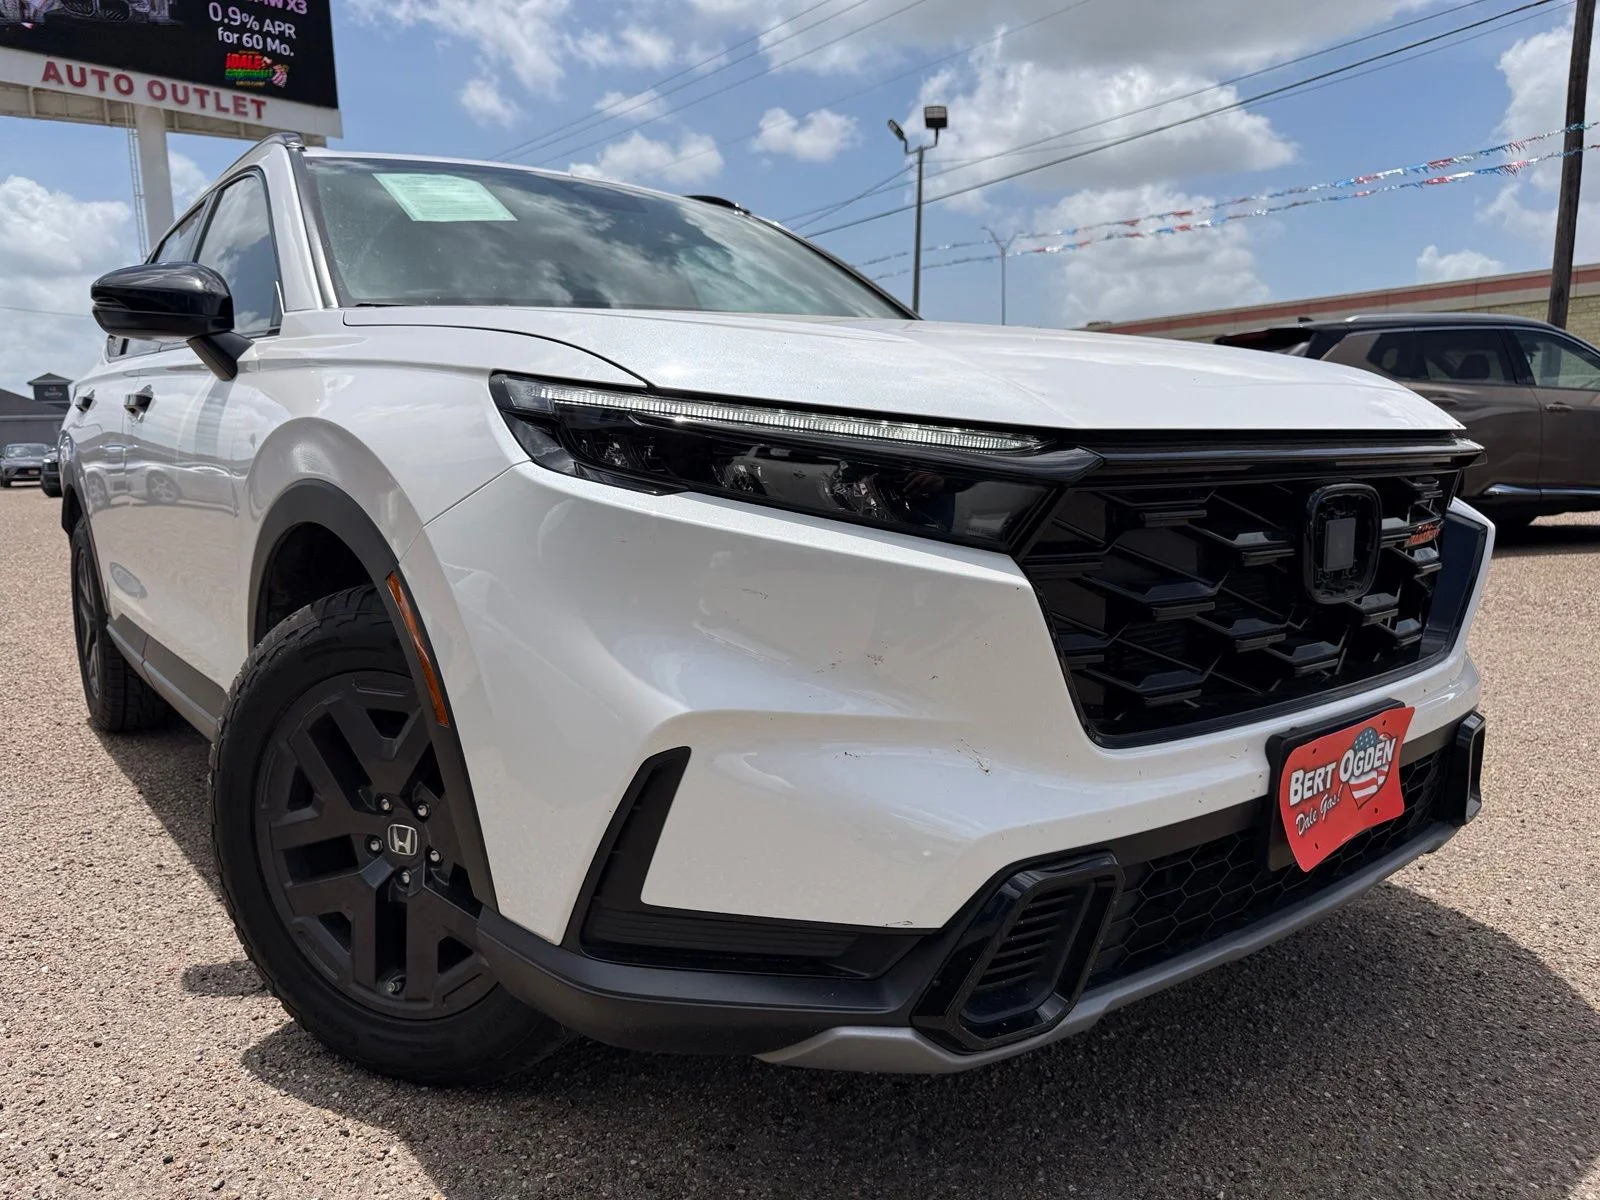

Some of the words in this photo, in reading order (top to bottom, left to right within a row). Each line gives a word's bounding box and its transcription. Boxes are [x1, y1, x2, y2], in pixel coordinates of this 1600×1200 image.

[208, 2, 260, 31] 0.9%
[263, 18, 297, 39] APR
[286, 0, 308, 15] X3
[217, 26, 240, 44] for
[242, 33, 263, 50] 60
[266, 37, 295, 57] Mo.
[41, 60, 135, 96] AUTO
[146, 79, 268, 119] OUTLET
[1288, 761, 1338, 807] BERT
[1339, 737, 1397, 783] OGDEN
[1295, 807, 1318, 836] Dale
